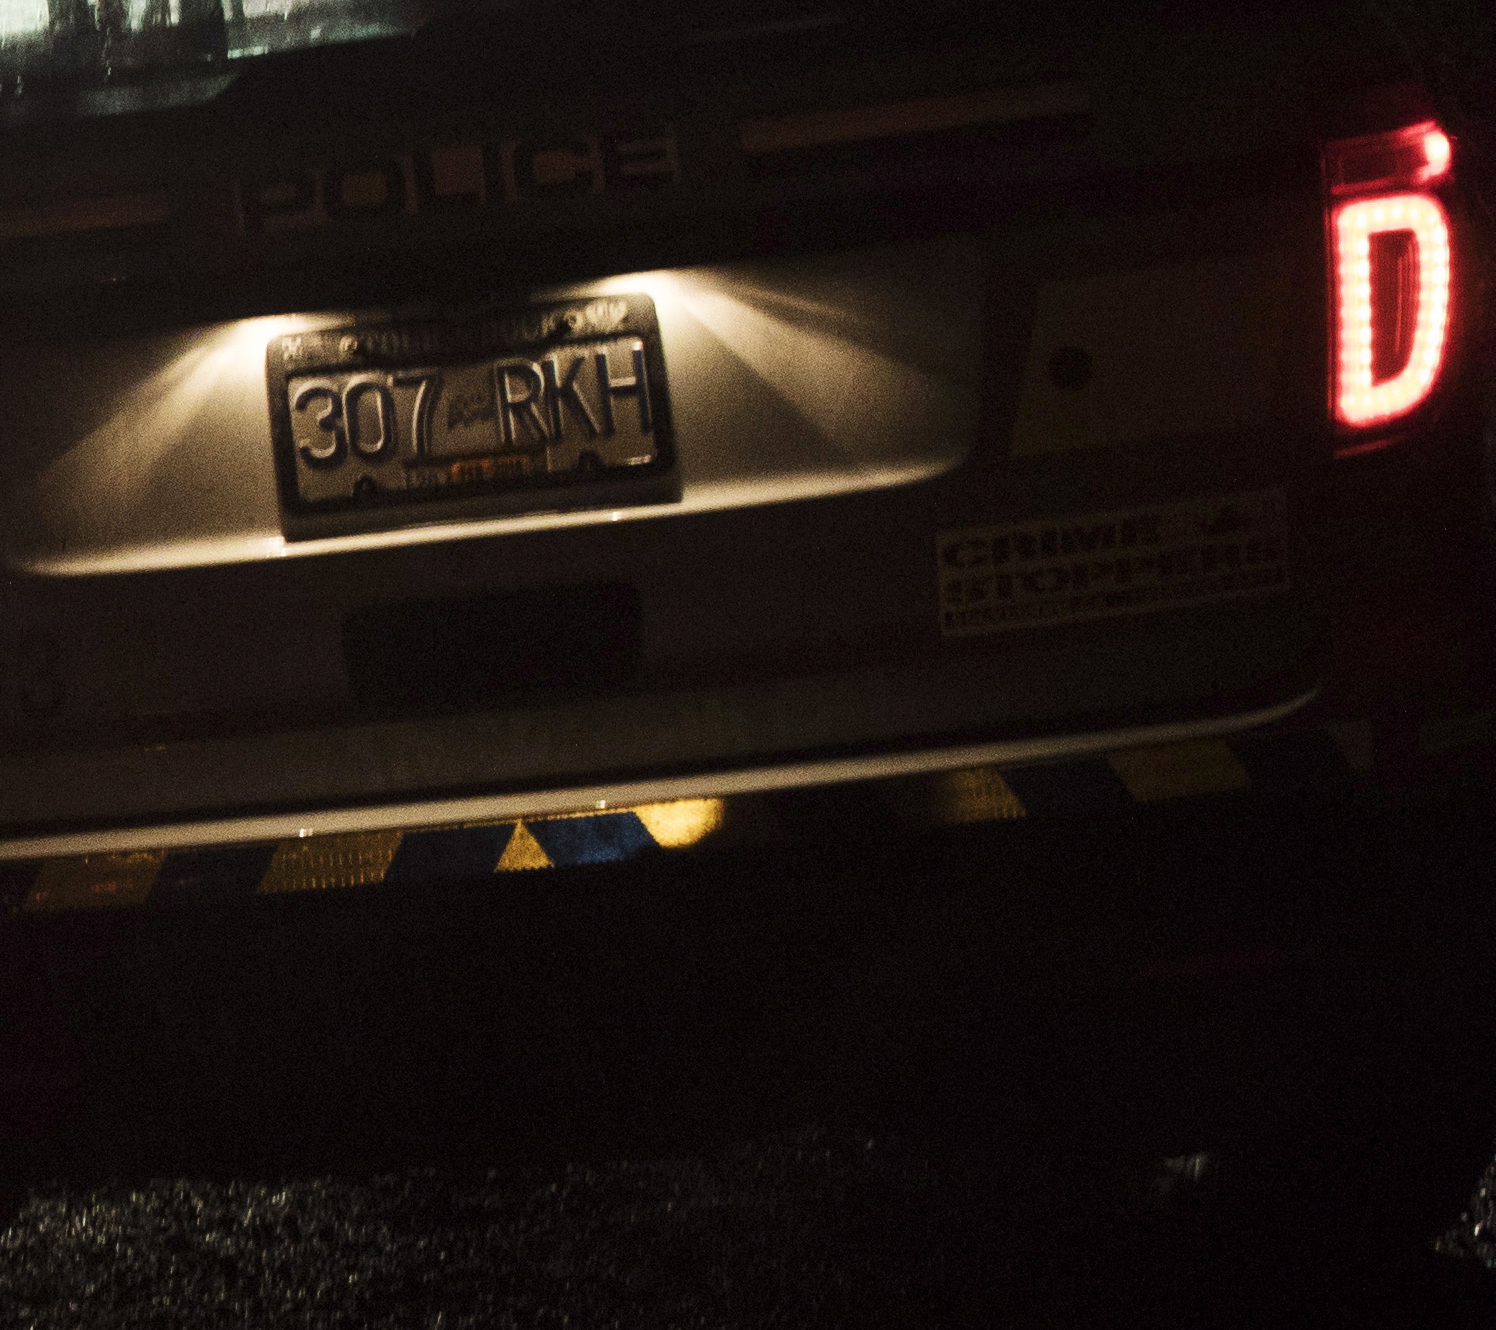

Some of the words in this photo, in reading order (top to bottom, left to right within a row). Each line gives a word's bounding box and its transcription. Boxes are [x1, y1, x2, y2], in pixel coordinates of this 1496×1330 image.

[244, 130, 667, 233] POLICE
[294, 373, 444, 469] 307
[494, 339, 654, 447] RKH
